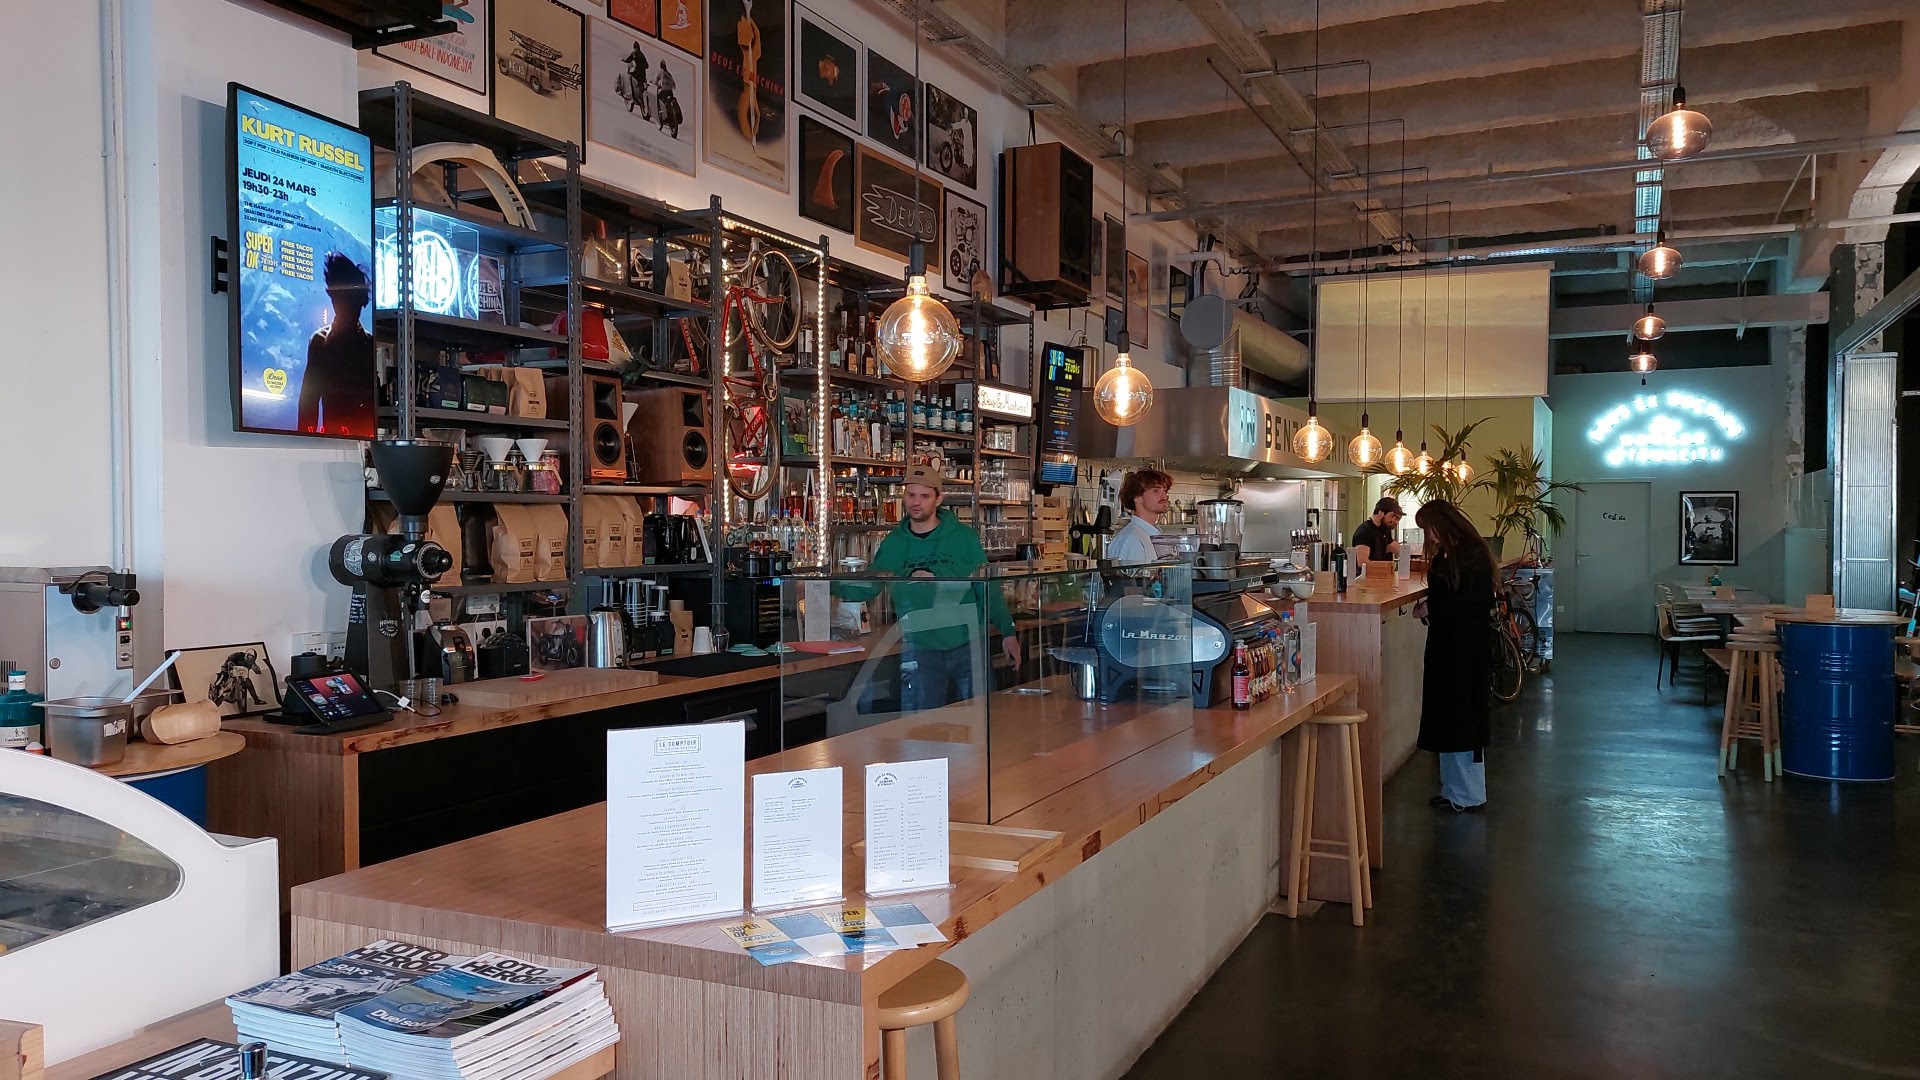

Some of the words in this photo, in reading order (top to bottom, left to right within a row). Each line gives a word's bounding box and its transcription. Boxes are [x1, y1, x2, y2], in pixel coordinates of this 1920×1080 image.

[508, 59, 526, 76] DEUS
[711, 51, 734, 71] DEUS
[242, 114, 296, 149] KURT
[298, 134, 365, 172] RUSSEL
[242, 166, 271, 183] JEUDI
[272, 176, 285, 187] 24
[286, 179, 317, 197] MARS
[242, 179, 289, 202] 19h30-23h
[243, 200, 253, 208] THE
[253, 202, 275, 214] HANGAR
[282, 210, 305, 221] TENACITY
[245, 230, 274, 255] SUPER
[281, 239, 296, 249] FREE
[296, 243, 314, 253] TACOS
[246, 249, 260, 270] OK
[281, 247, 296, 256] FREE
[296, 250, 314, 260] TACOS
[281, 254, 296, 263] FREE
[296, 257, 314, 267] TACOS
[281, 261, 296, 270] FREE
[296, 264, 314, 274] TACOS
[281, 269, 296, 278] FREE
[296, 271, 314, 281] TACOS
[1240, 405, 1257, 447] IN
[460, 961, 562, 985] HEROES
